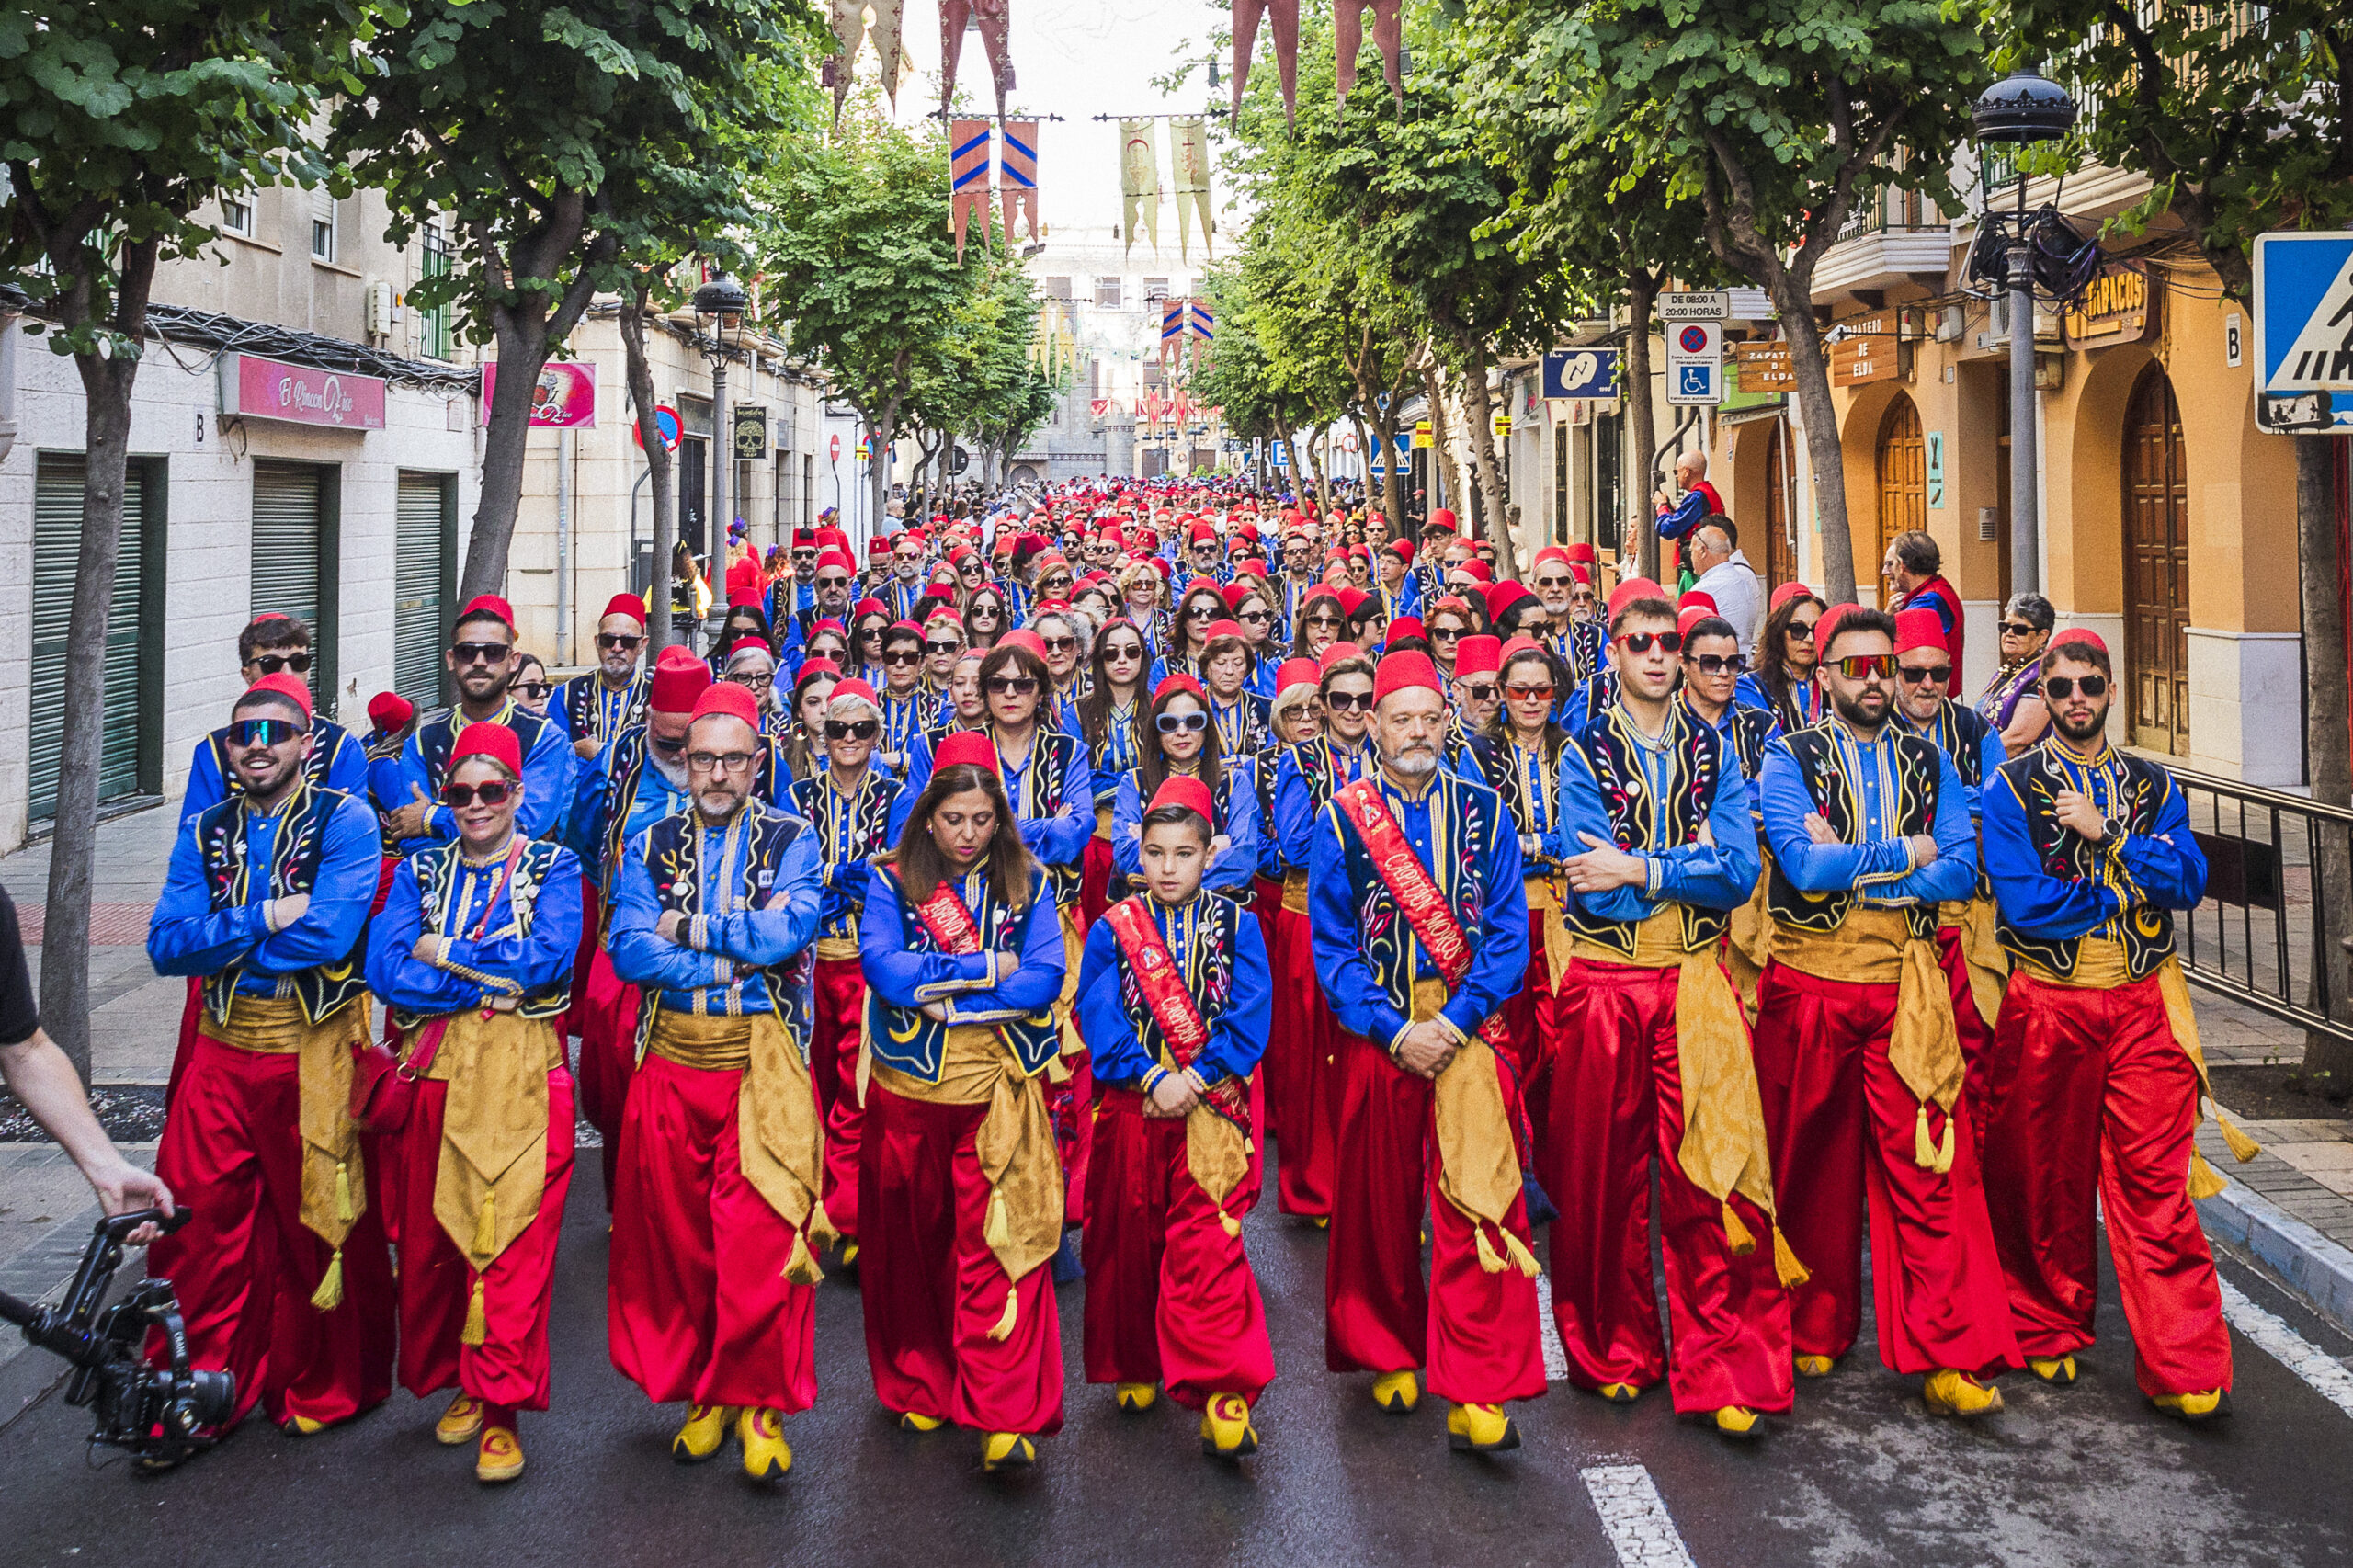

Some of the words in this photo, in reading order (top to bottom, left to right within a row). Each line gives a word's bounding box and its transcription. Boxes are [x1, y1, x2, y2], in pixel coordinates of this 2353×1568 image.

[1671, 295, 1684, 304] DE
[1686, 295, 1708, 304] 08:00
[1710, 295, 1716, 304] A
[2086, 271, 2143, 316] TABACOS
[1665, 308, 1688, 316] 20:00
[1689, 307, 1722, 316] HORAS
[1858, 342, 1868, 358] DE
[2228, 327, 2239, 359] B
[1749, 351, 1790, 359] ZAPAT
[1771, 362, 1786, 370] DE
[1853, 360, 1873, 377] ELDA
[1763, 372, 1794, 381] ELDA
[279, 377, 292, 406] El
[197, 414, 204, 442] B
[1384, 852, 1438, 913] CAPITÁN
[1422, 910, 1464, 960] MOROS
[174, 1331, 186, 1358] CRANE
